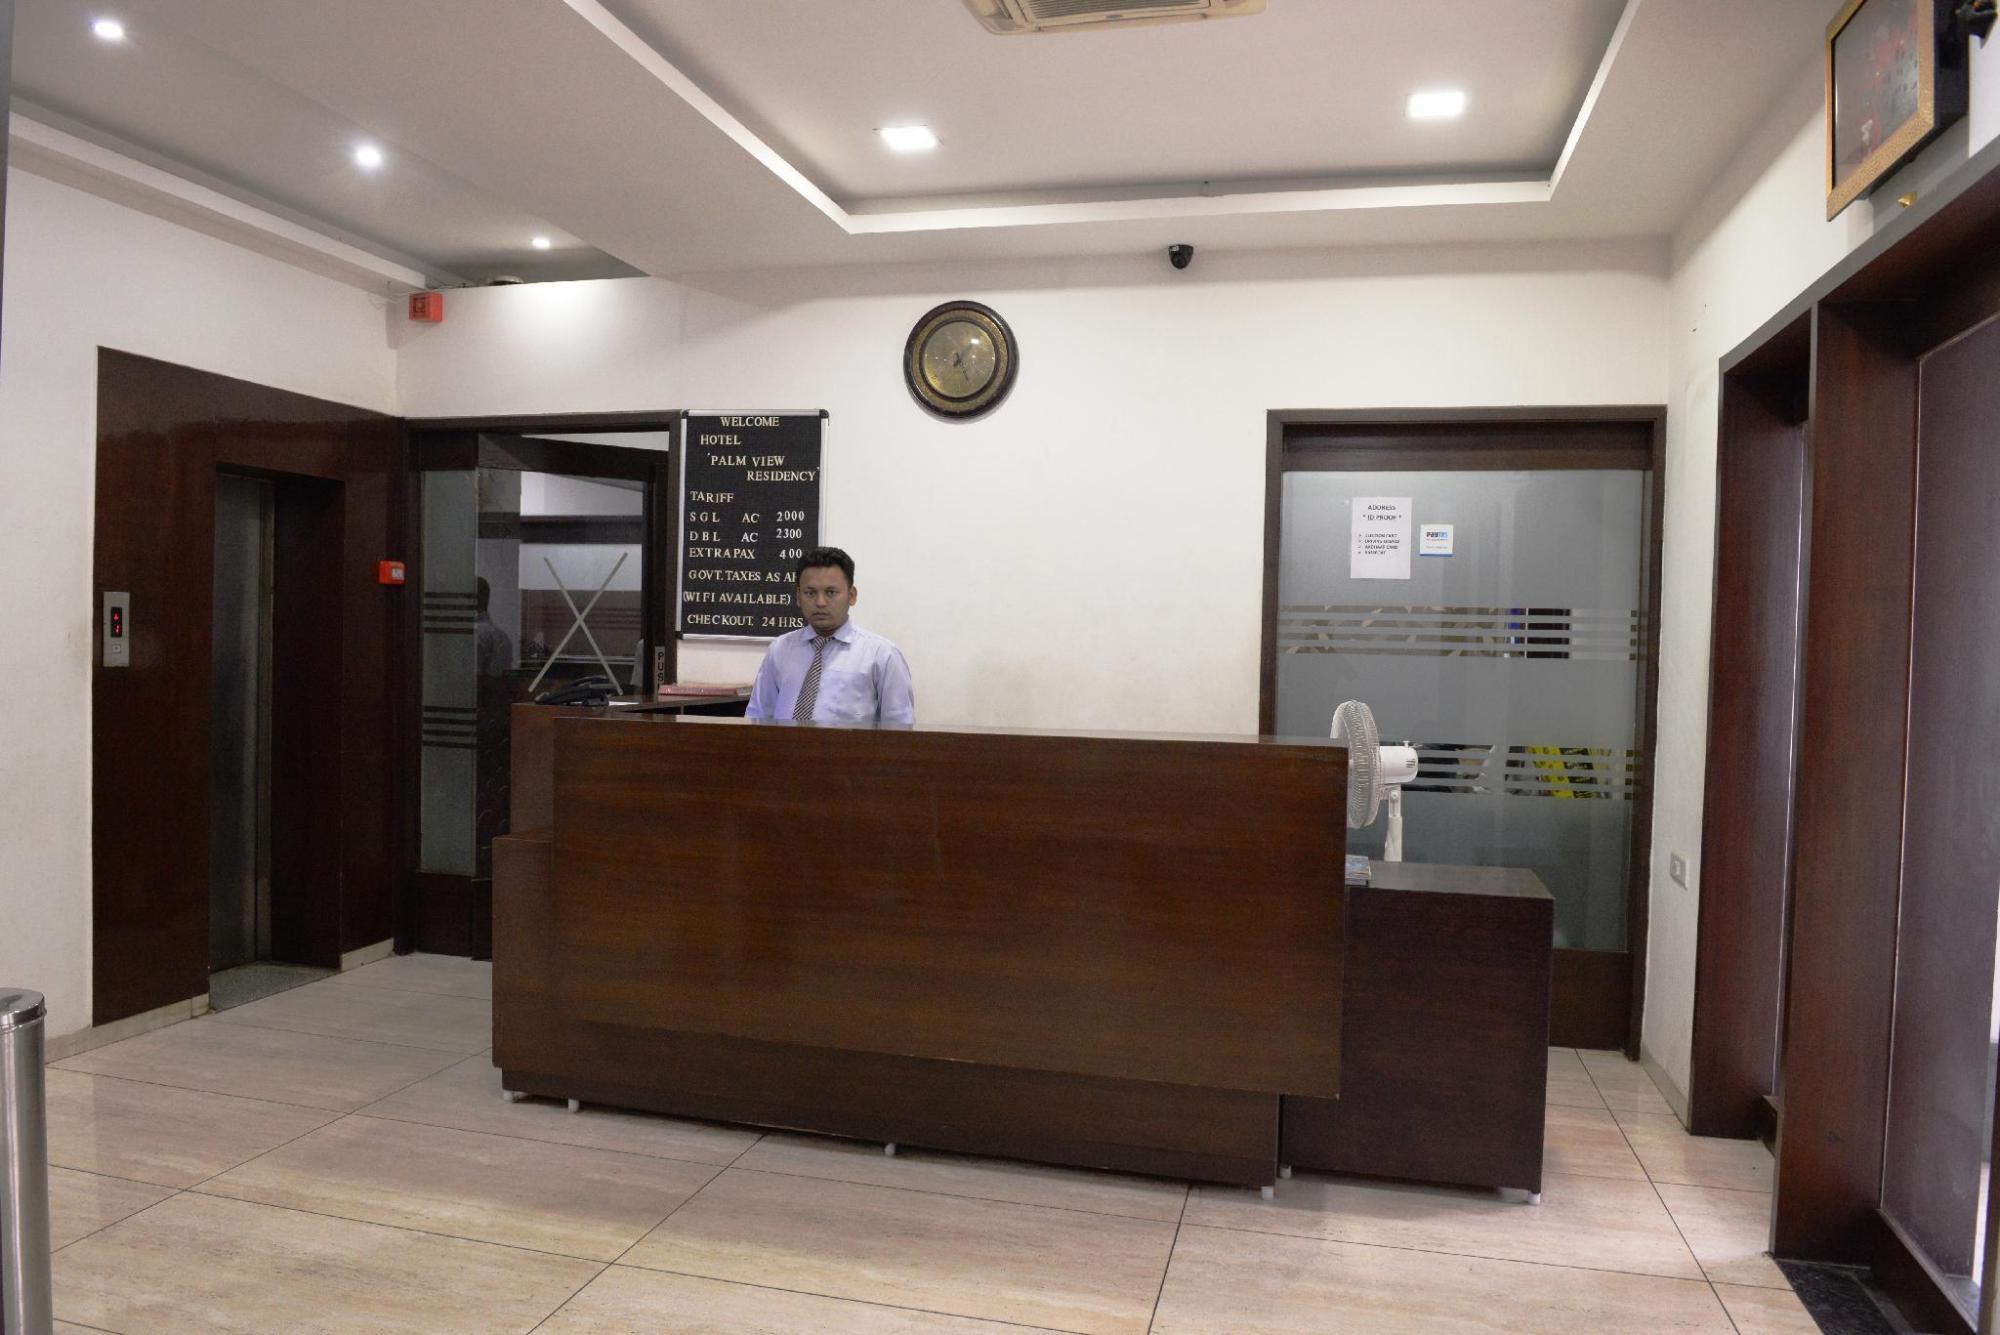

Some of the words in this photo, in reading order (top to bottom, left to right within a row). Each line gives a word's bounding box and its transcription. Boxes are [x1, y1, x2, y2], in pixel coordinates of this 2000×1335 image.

[720, 416, 780, 427] WELCOME
[700, 434, 742, 445] HOTEL
[711, 455, 747, 466] PALM
[752, 455, 785, 467] VIEW
[747, 470, 816, 482] RESIDENCY
[689, 490, 735, 503] TARIFF
[742, 513, 760, 523] AC
[776, 511, 805, 522] 2000
[741, 532, 759, 543] AC
[776, 528, 802, 539] 2300
[779, 548, 803, 559] 400
[765, 571, 781, 582] AS
[761, 616, 776, 627] 24
